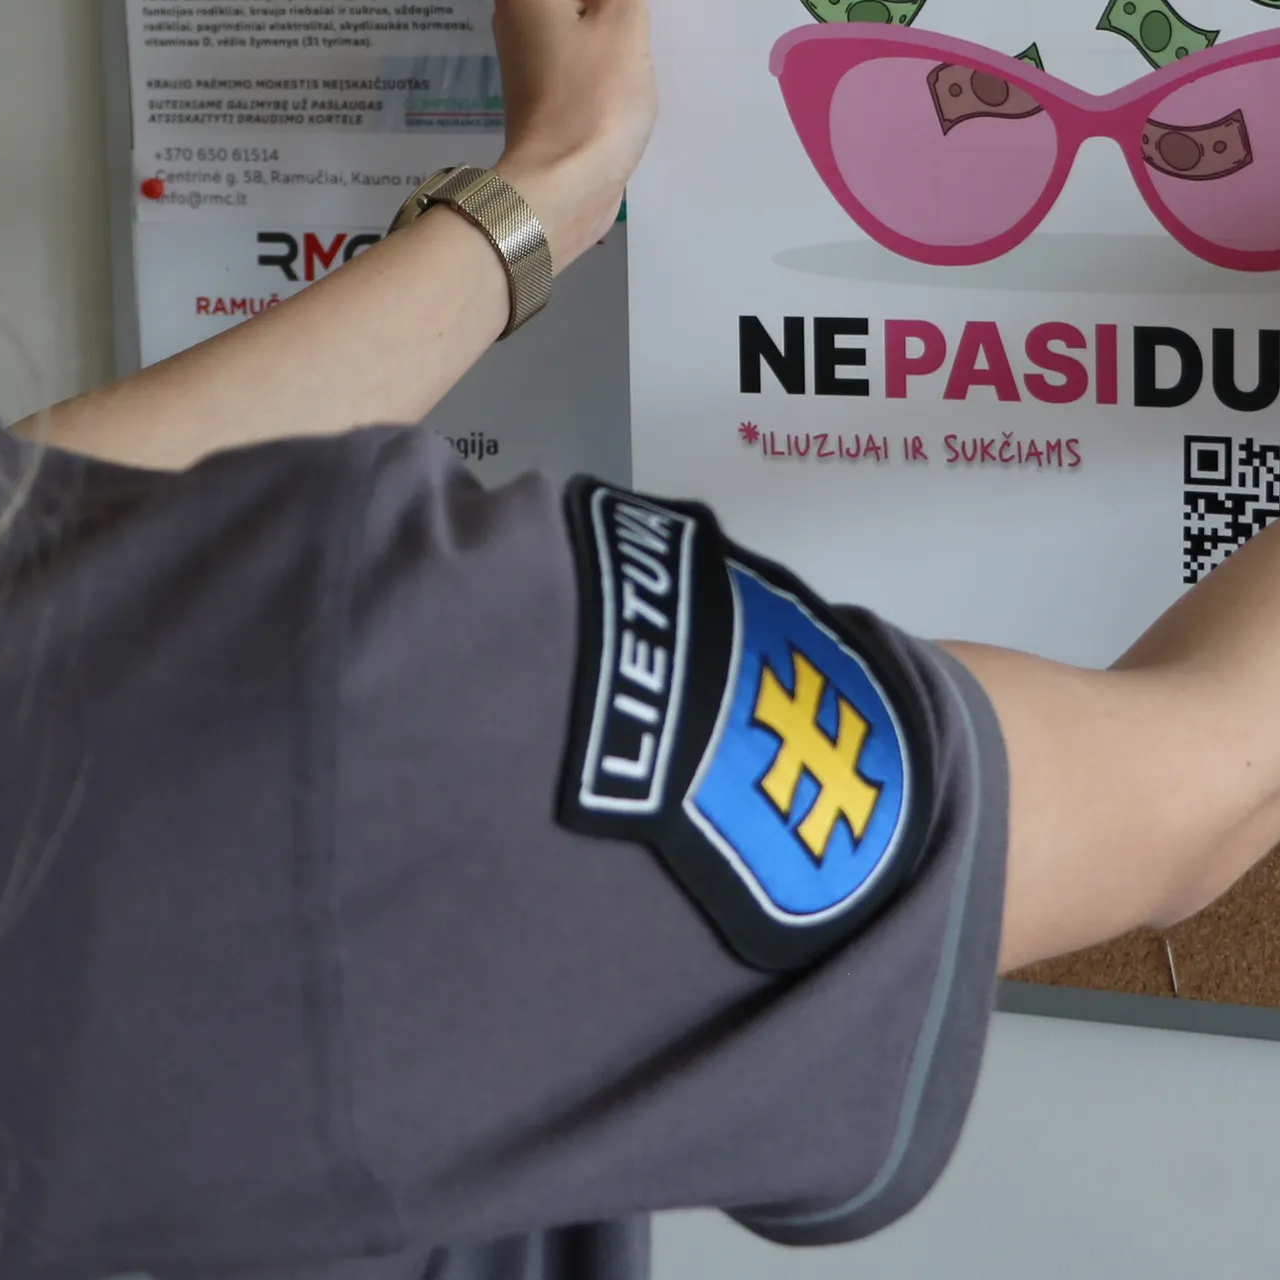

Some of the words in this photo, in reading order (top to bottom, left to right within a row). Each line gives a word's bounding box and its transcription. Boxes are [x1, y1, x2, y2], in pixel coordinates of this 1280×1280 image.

[155, 147, 193, 162] +370
[197, 148, 228, 162] 650
[232, 148, 279, 162] 61514
[351, 173, 402, 186] Kauno
[904, 436, 928, 460] IR
[944, 432, 1081, 468] SUKČIAMS
